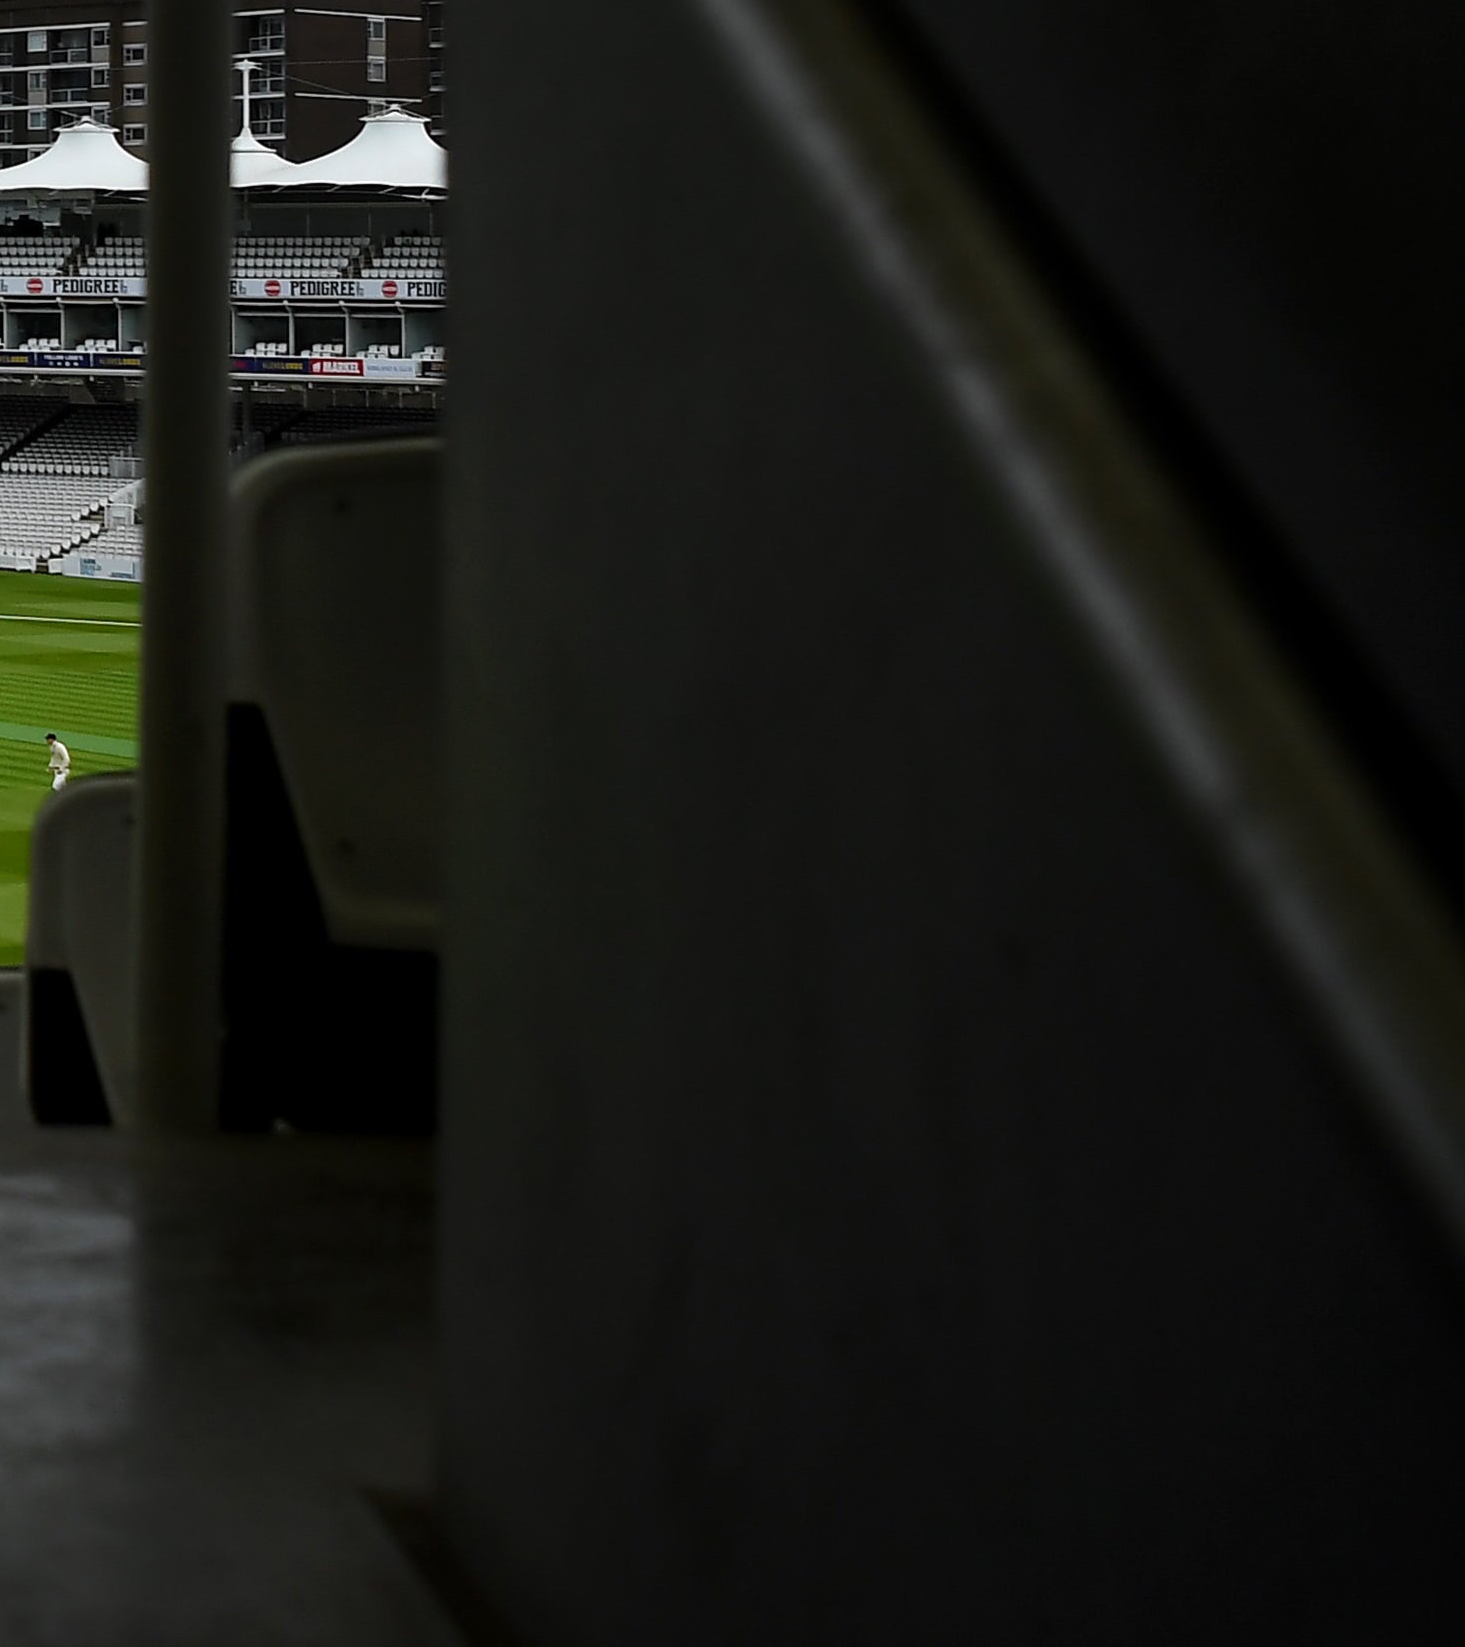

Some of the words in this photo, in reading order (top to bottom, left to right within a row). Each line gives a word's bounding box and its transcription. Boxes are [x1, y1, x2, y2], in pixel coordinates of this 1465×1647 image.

[52, 279, 119, 294] PEDIGREE
[290, 280, 355, 296] PEDIGREE
[406, 281, 446, 297] PEDIG
